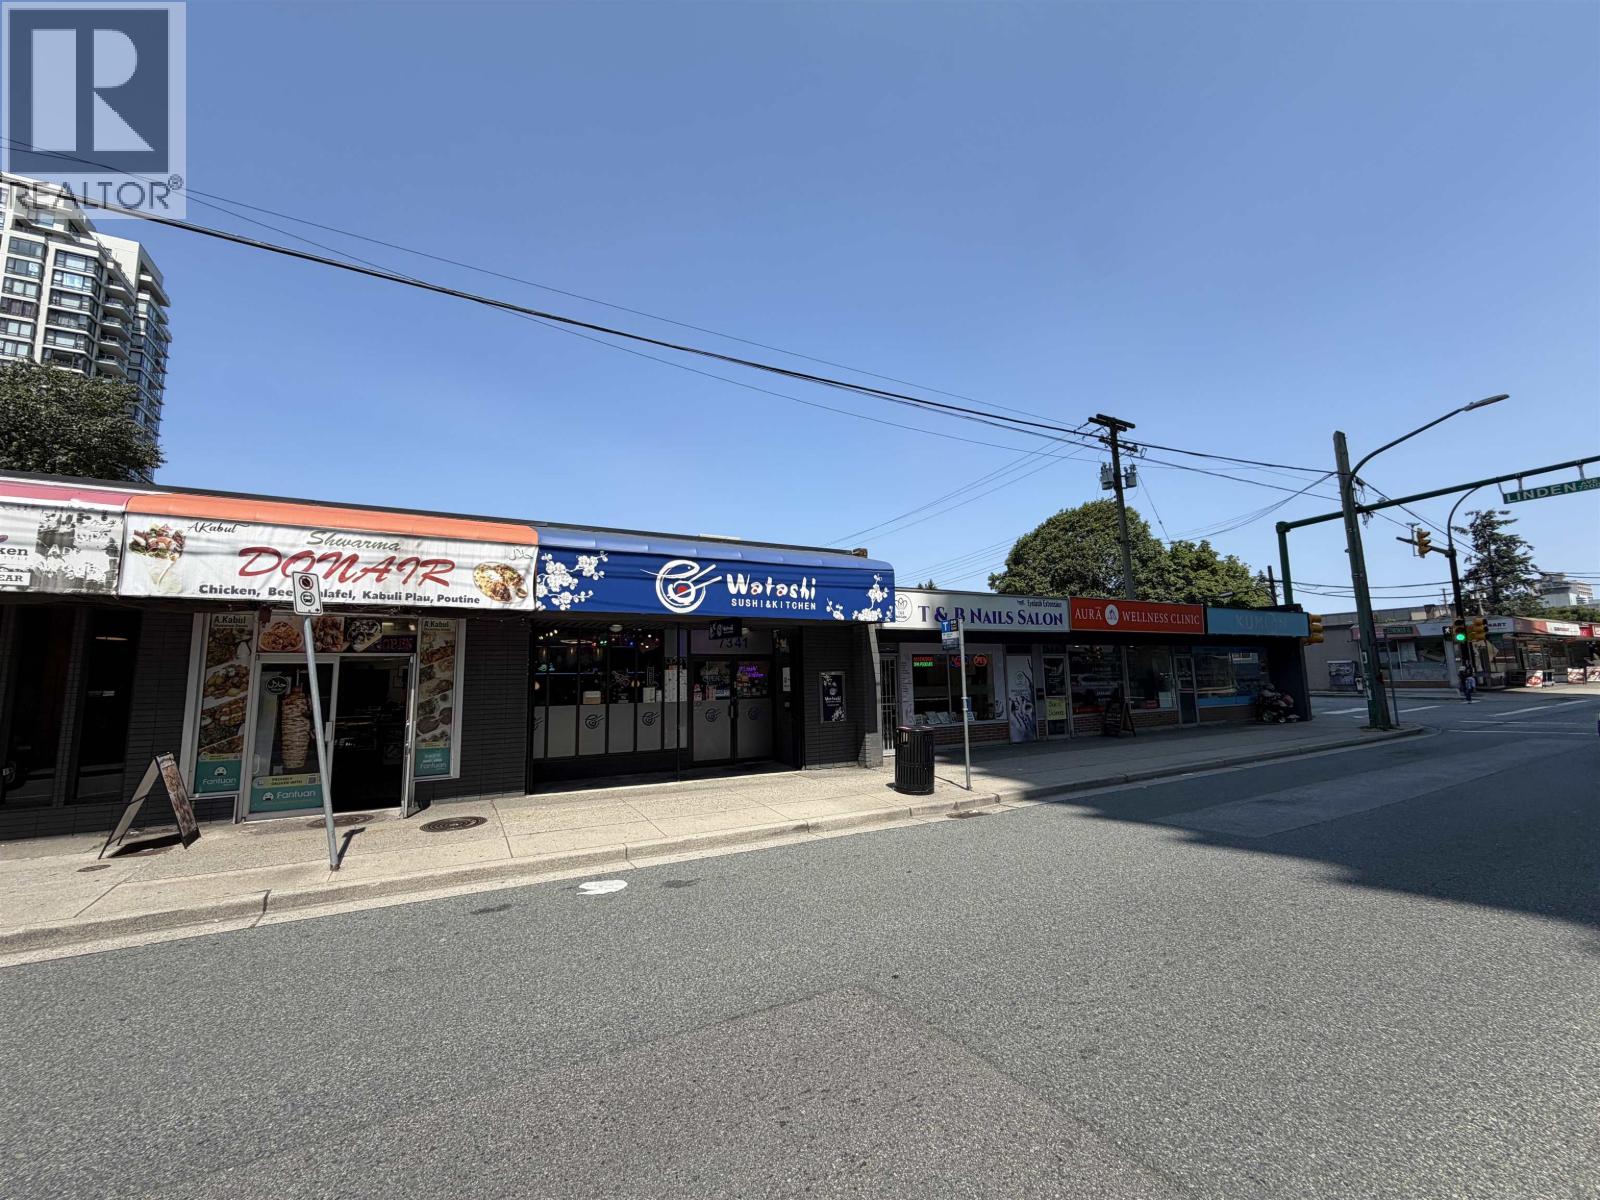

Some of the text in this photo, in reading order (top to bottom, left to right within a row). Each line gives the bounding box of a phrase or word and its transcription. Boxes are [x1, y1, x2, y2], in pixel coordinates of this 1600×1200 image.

[1506, 482, 1577, 503] LINDEN
[306, 531, 401, 551] Shwarma
[238, 546, 456, 588] DONAIR
[198, 584, 261, 598] Chicken,
[268, 587, 293, 597] Bee
[362, 590, 402, 601] Kabuli
[437, 594, 480, 604] Poutine
[726, 573, 816, 600] Watashi
[918, 605, 930, 622] T
[934, 606, 948, 622] &
[1122, 611, 1169, 625] WELLNESS
[1170, 613, 1200, 625] CLINIC
[276, 790, 316, 799] Fantuan
